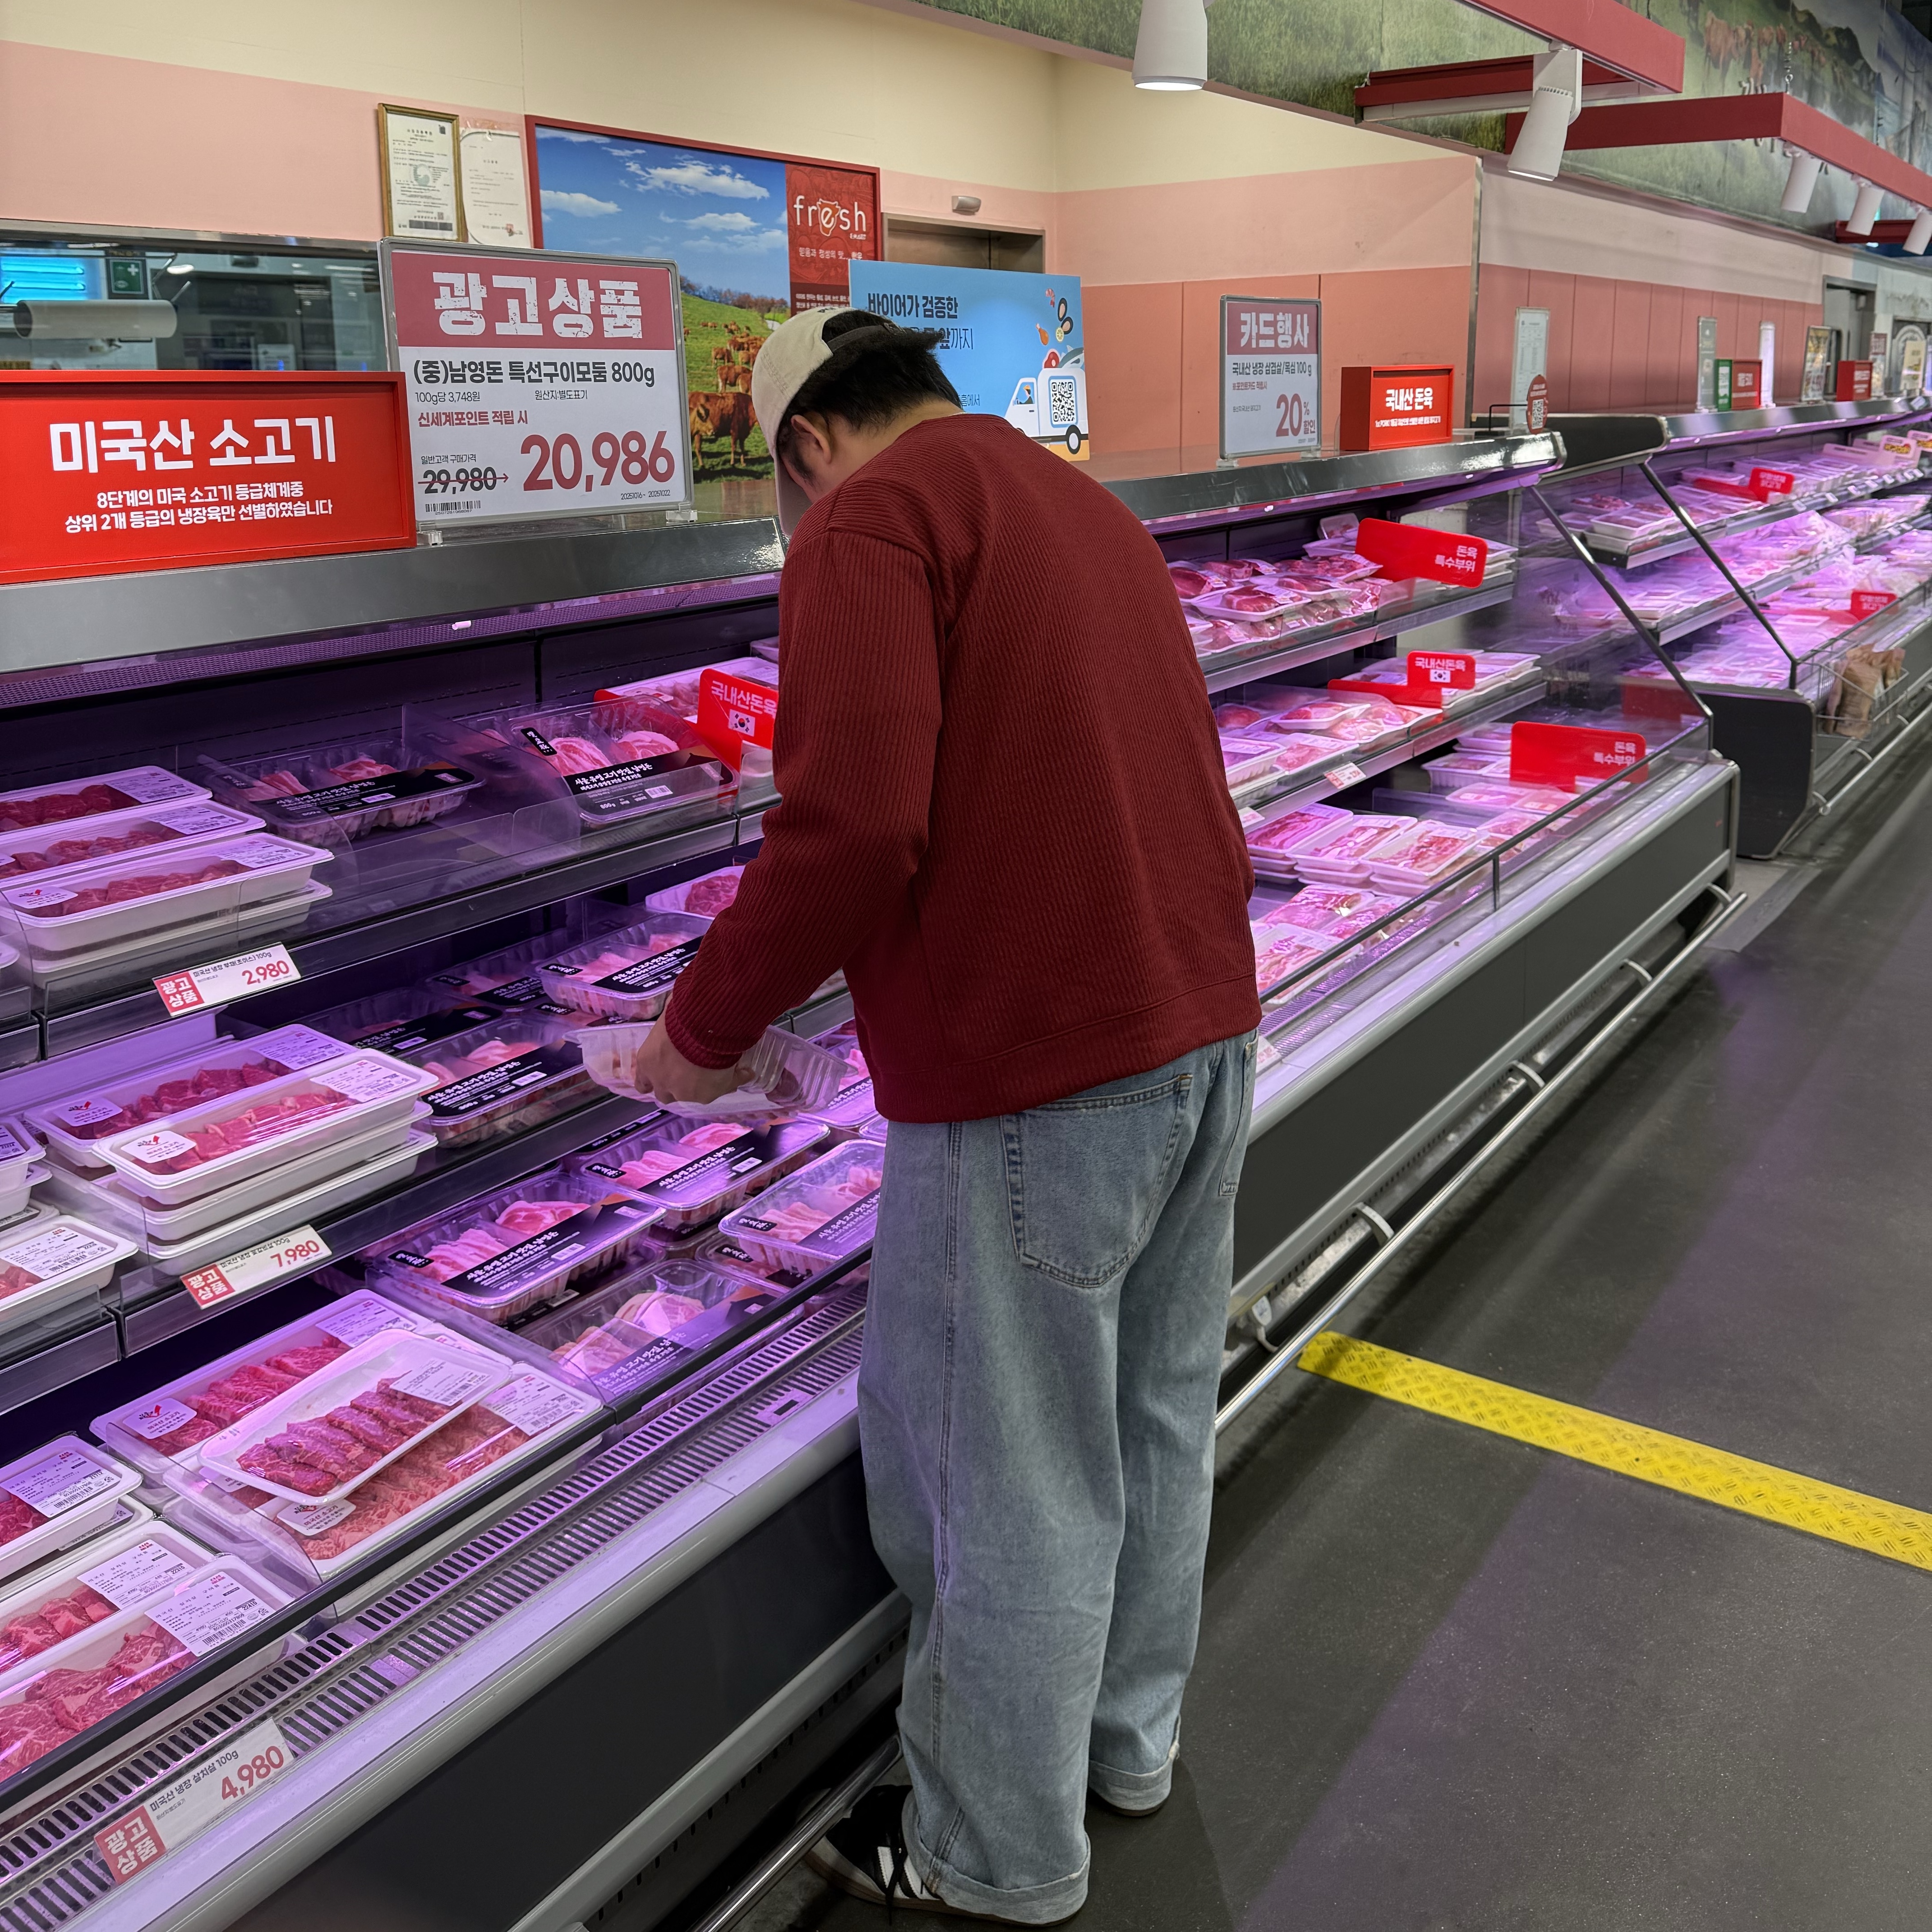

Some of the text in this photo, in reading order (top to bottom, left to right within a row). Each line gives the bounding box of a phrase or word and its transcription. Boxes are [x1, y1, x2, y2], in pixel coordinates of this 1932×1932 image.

[793, 195, 866, 231] fresh
[432, 271, 643, 339] 광고상품
[868, 293, 958, 319] 바이어가 검증한
[1240, 312, 1309, 348] 카드행사
[414, 360, 655, 387] (중)남영돈 특선구이모둠 800g
[1232, 361, 1311, 376] 국내산 냉장 삼겹살/목심 100 g
[415, 390, 588, 405] 100g당 3,748원 원산지:별도표기
[1386, 387, 1433, 411] 국내산 돈육
[418, 410, 528, 428] 신세계포인트 적립 시
[1276, 393, 1310, 437] 20 %
[1303, 419, 1315, 434] 할인
[50, 416, 336, 473] 미국산 소고기
[421, 454, 477, 465] 일반고객 구매가격
[520, 430, 675, 492] 20,986
[423, 466, 497, 494] 29,980
[97, 481, 304, 509] 8단계의 미국 소고기 등급체계중
[65, 499, 333, 534] 상위 2개 등급의 냉장육만 선별하였습니다
[1435, 555, 1476, 572] 특수부위
[1457, 545, 1478, 559] 돈육
[1415, 657, 1466, 672] 국내산돈육
[711, 681, 778, 714] 국내산돈육
[1594, 752, 1635, 767] 특수부위
[1615, 741, 1636, 754] 돈육
[590, 774, 604, 782] 유명
[632, 763, 652, 773] 남영돈
[193, 966, 210, 978] 미국산
[211, 963, 223, 972] 냉장
[241, 959, 290, 986] 2,980
[159, 977, 197, 996] 광고
[168, 990, 200, 1008] 상품
[220, 1257, 238, 1269] 미국산
[272, 1237, 291, 1246] 100g
[270, 1240, 320, 1269] 7,980
[187, 1271, 218, 1289] 광고
[197, 1283, 228, 1301] 상품
[303, 1505, 338, 1525] 미국산 소고기
[243, 1601, 257, 1610] 22410
[149, 1749, 239, 1812] 미국산 냉장 살치살 100g
[221, 1745, 284, 1800] 4,980
[104, 1816, 148, 1854] 광고
[117, 1835, 157, 1874] 상품
